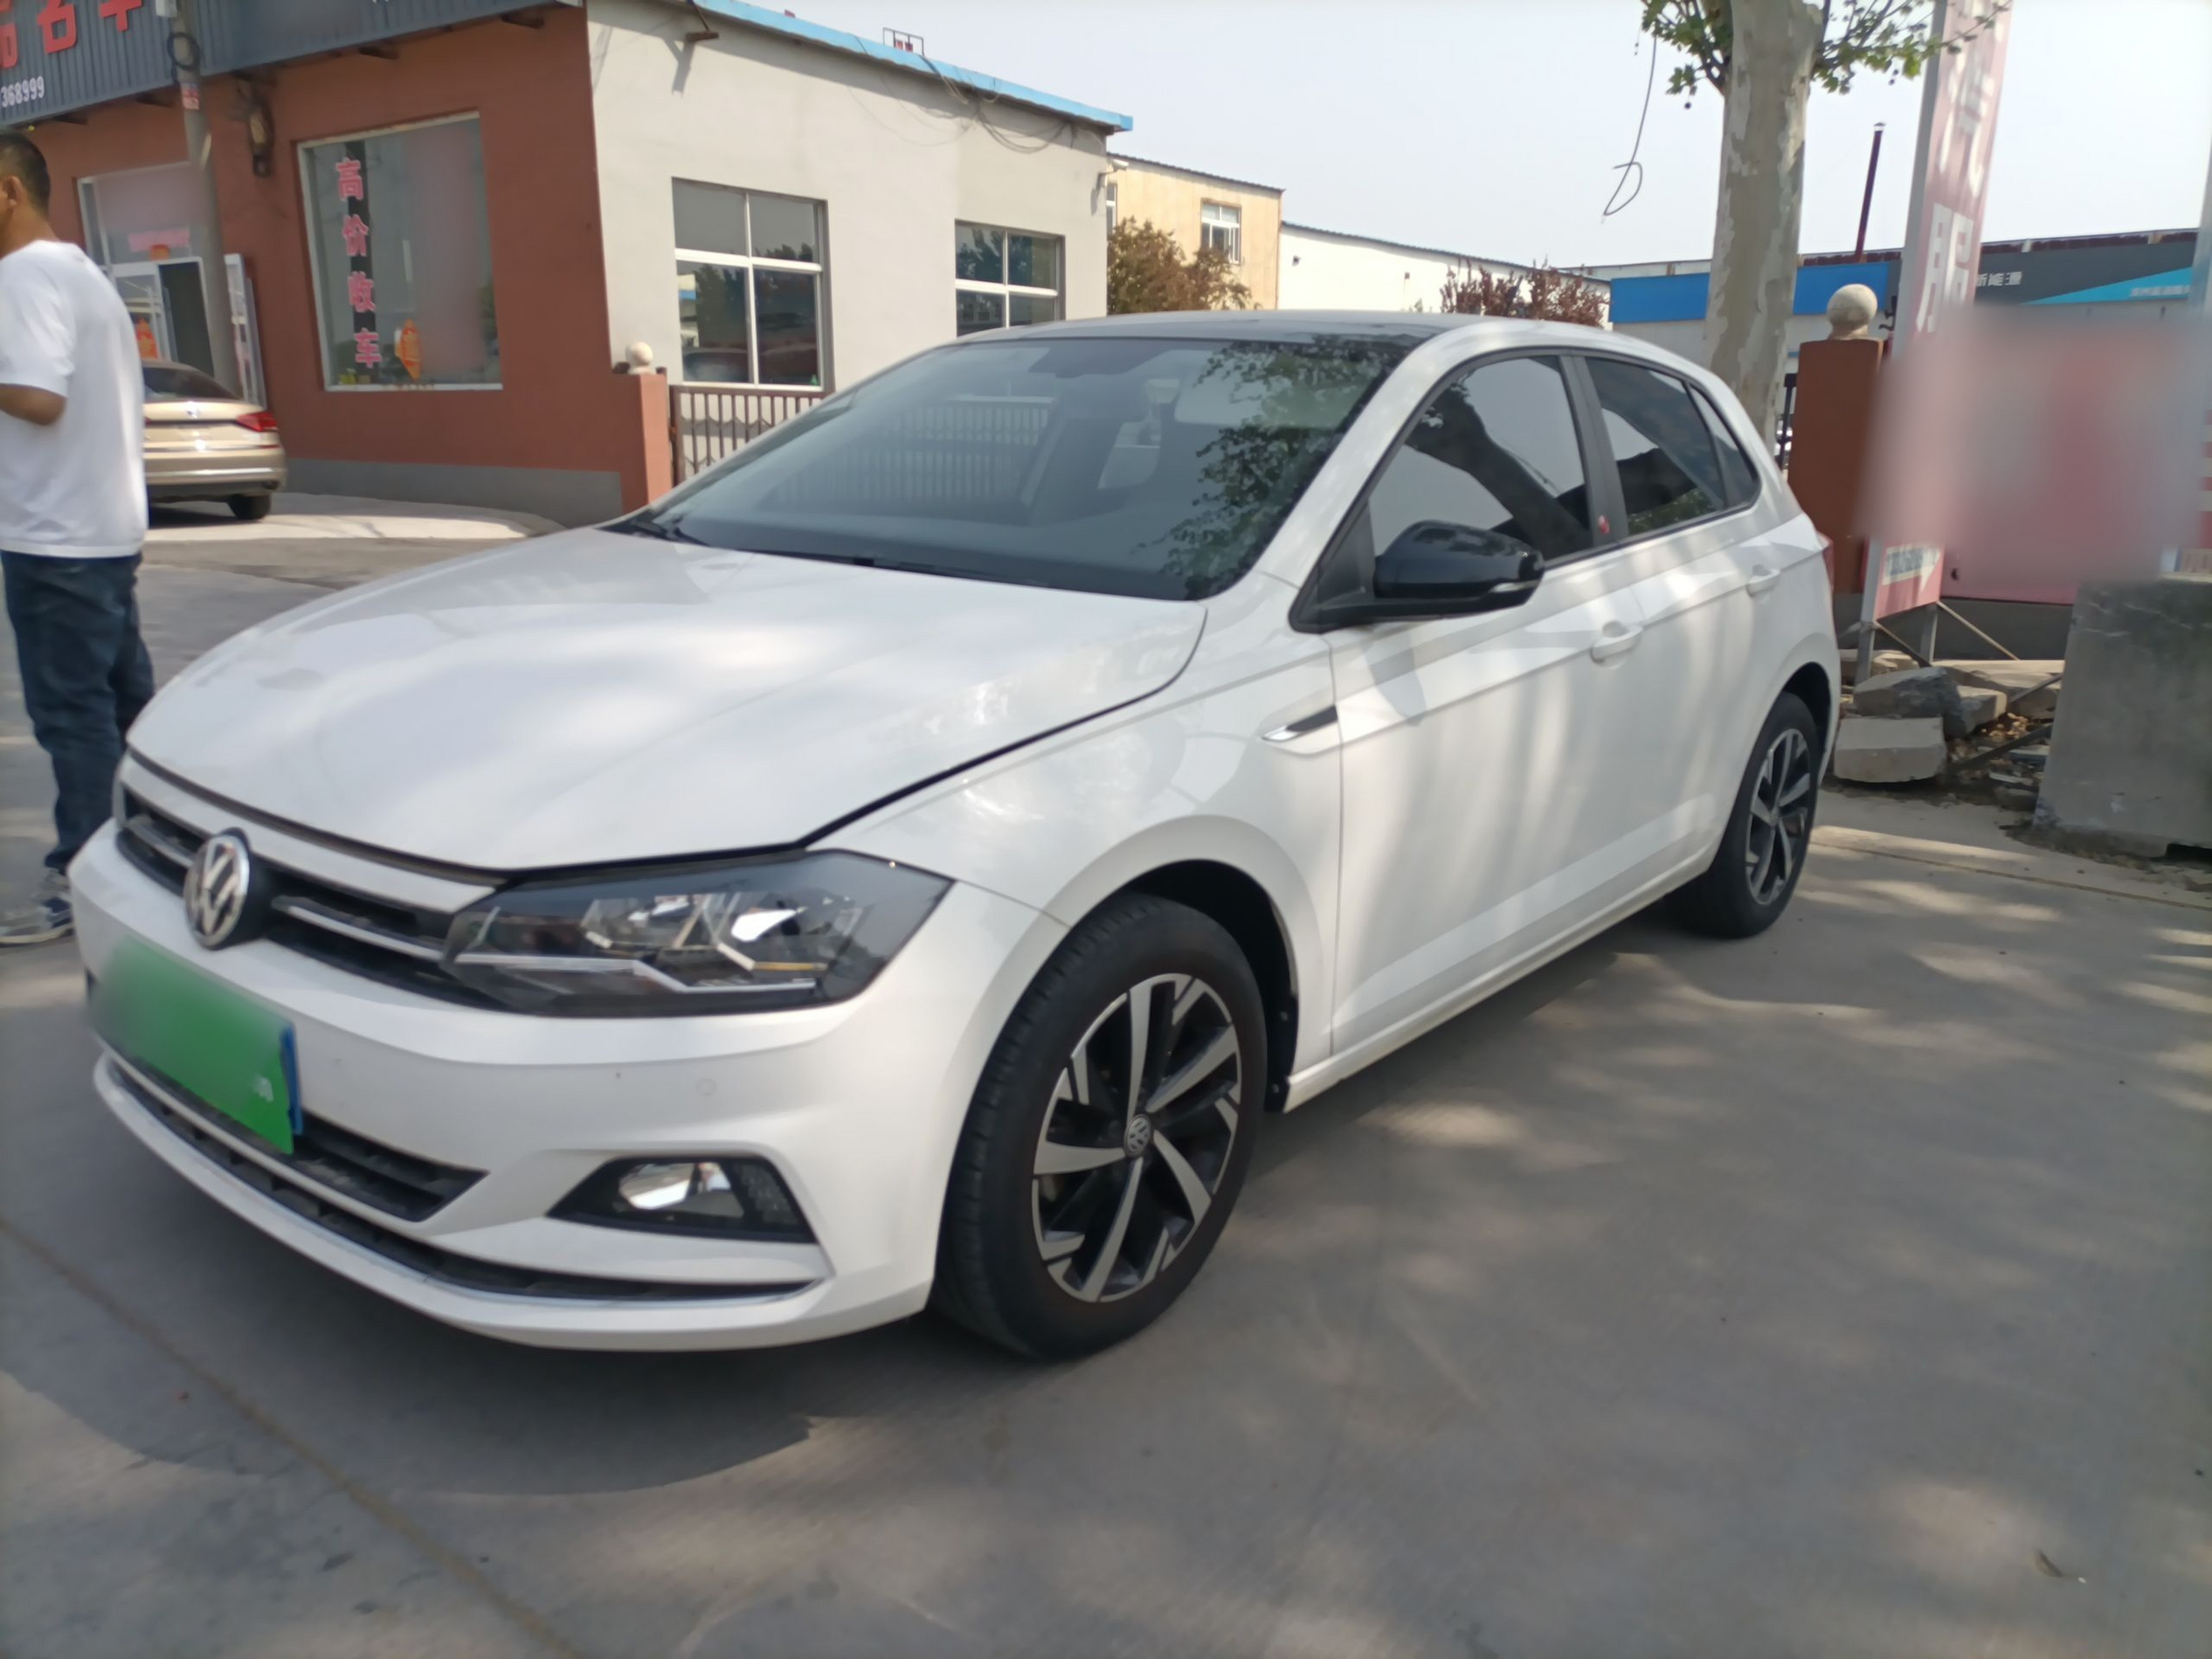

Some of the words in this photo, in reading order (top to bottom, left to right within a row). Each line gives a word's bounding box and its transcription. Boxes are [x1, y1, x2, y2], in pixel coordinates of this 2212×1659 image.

[1, 75, 45, 108] 368999
[336, 157, 382, 369] 高价收车
